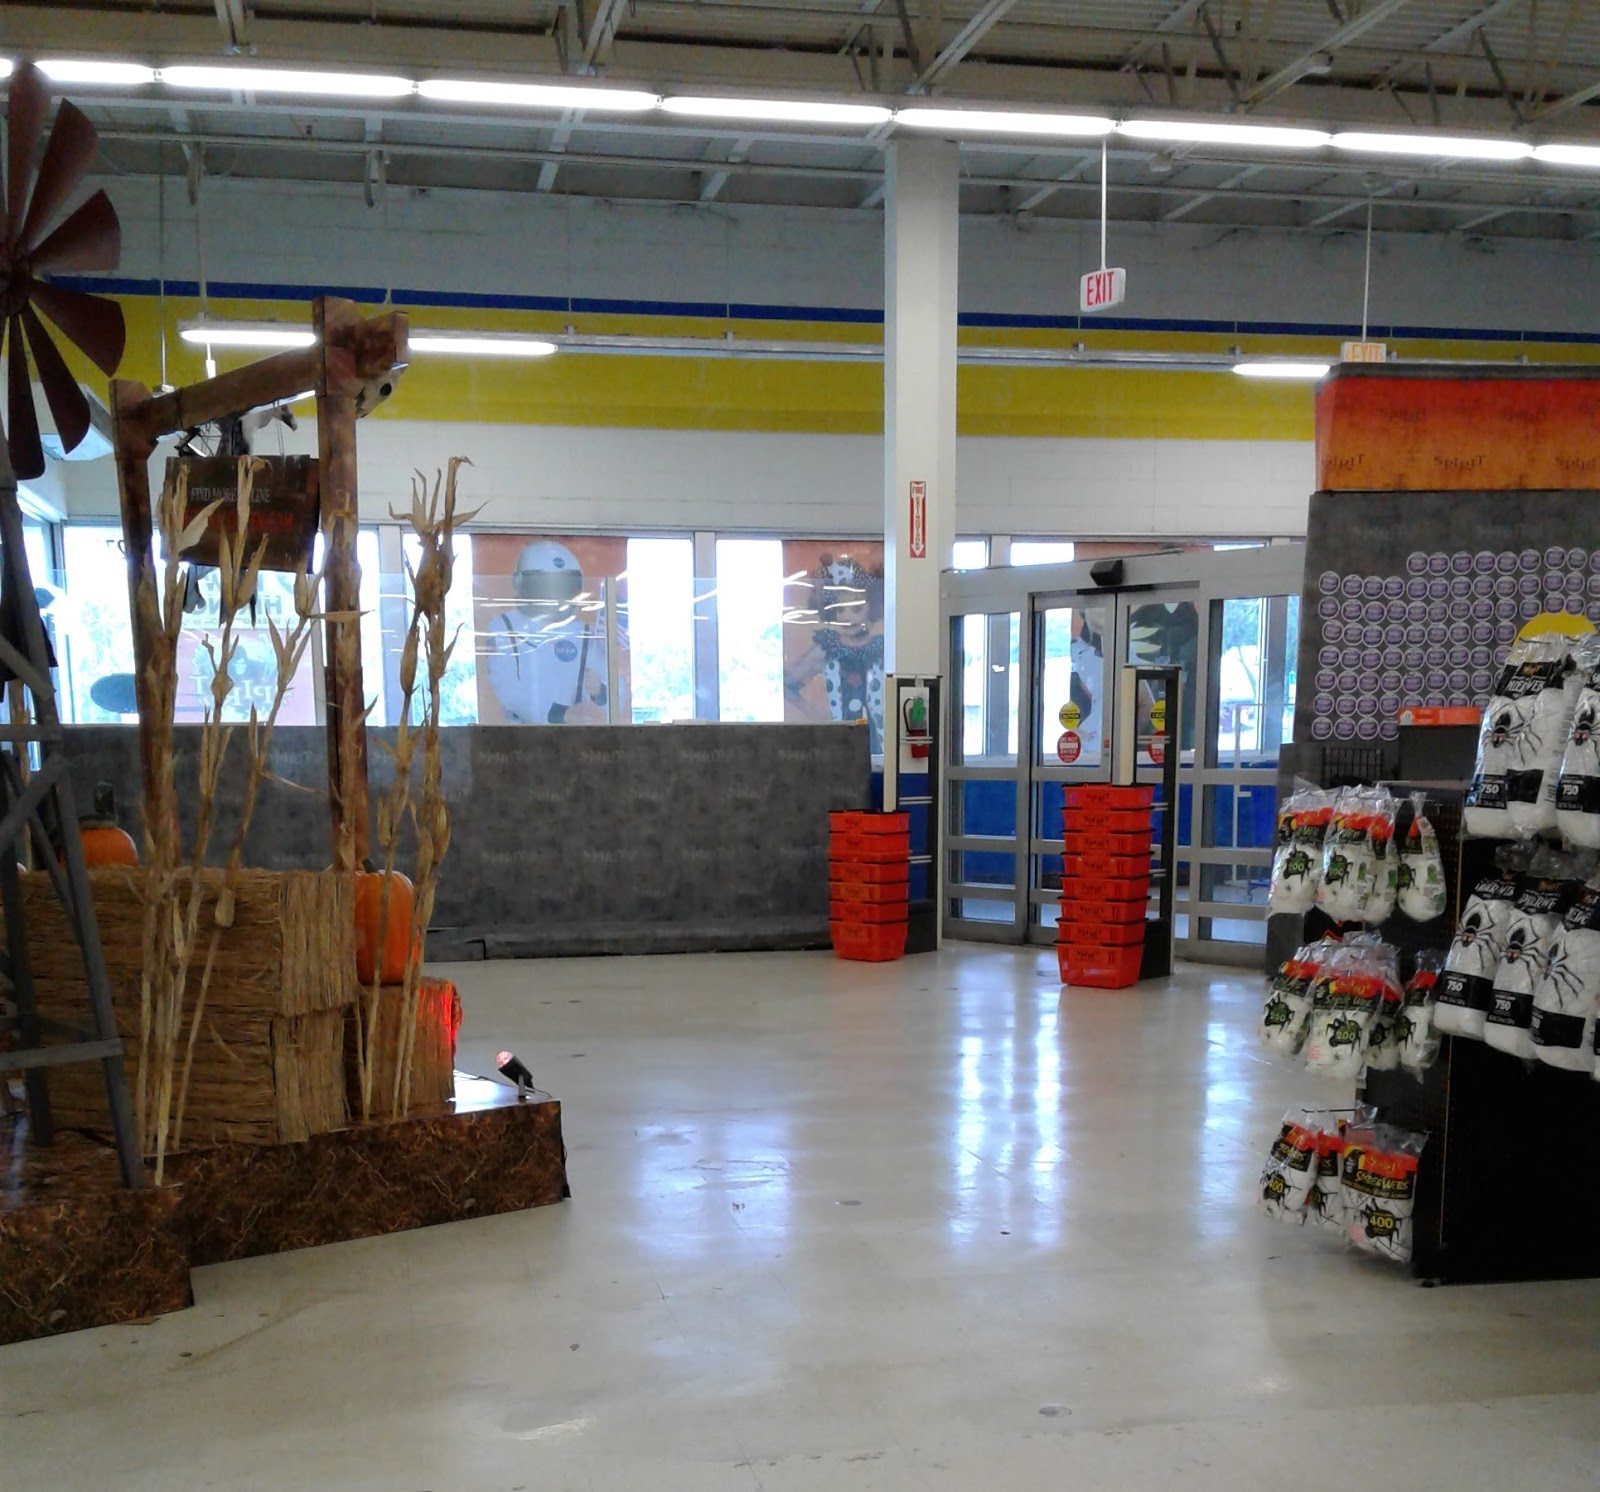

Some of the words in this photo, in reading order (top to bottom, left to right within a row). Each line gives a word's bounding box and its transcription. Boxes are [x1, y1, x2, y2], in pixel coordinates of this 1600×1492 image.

[1086, 271, 1115, 307] EXIT
[1480, 784, 1499, 794] 750
[1562, 785, 1579, 795] 750
[1447, 981, 1463, 992] 750
[1495, 999, 1511, 1011] 750
[1336, 1031, 1356, 1041] 200
[1267, 1179, 1283, 1193] 400
[1369, 1216, 1394, 1229] 400
